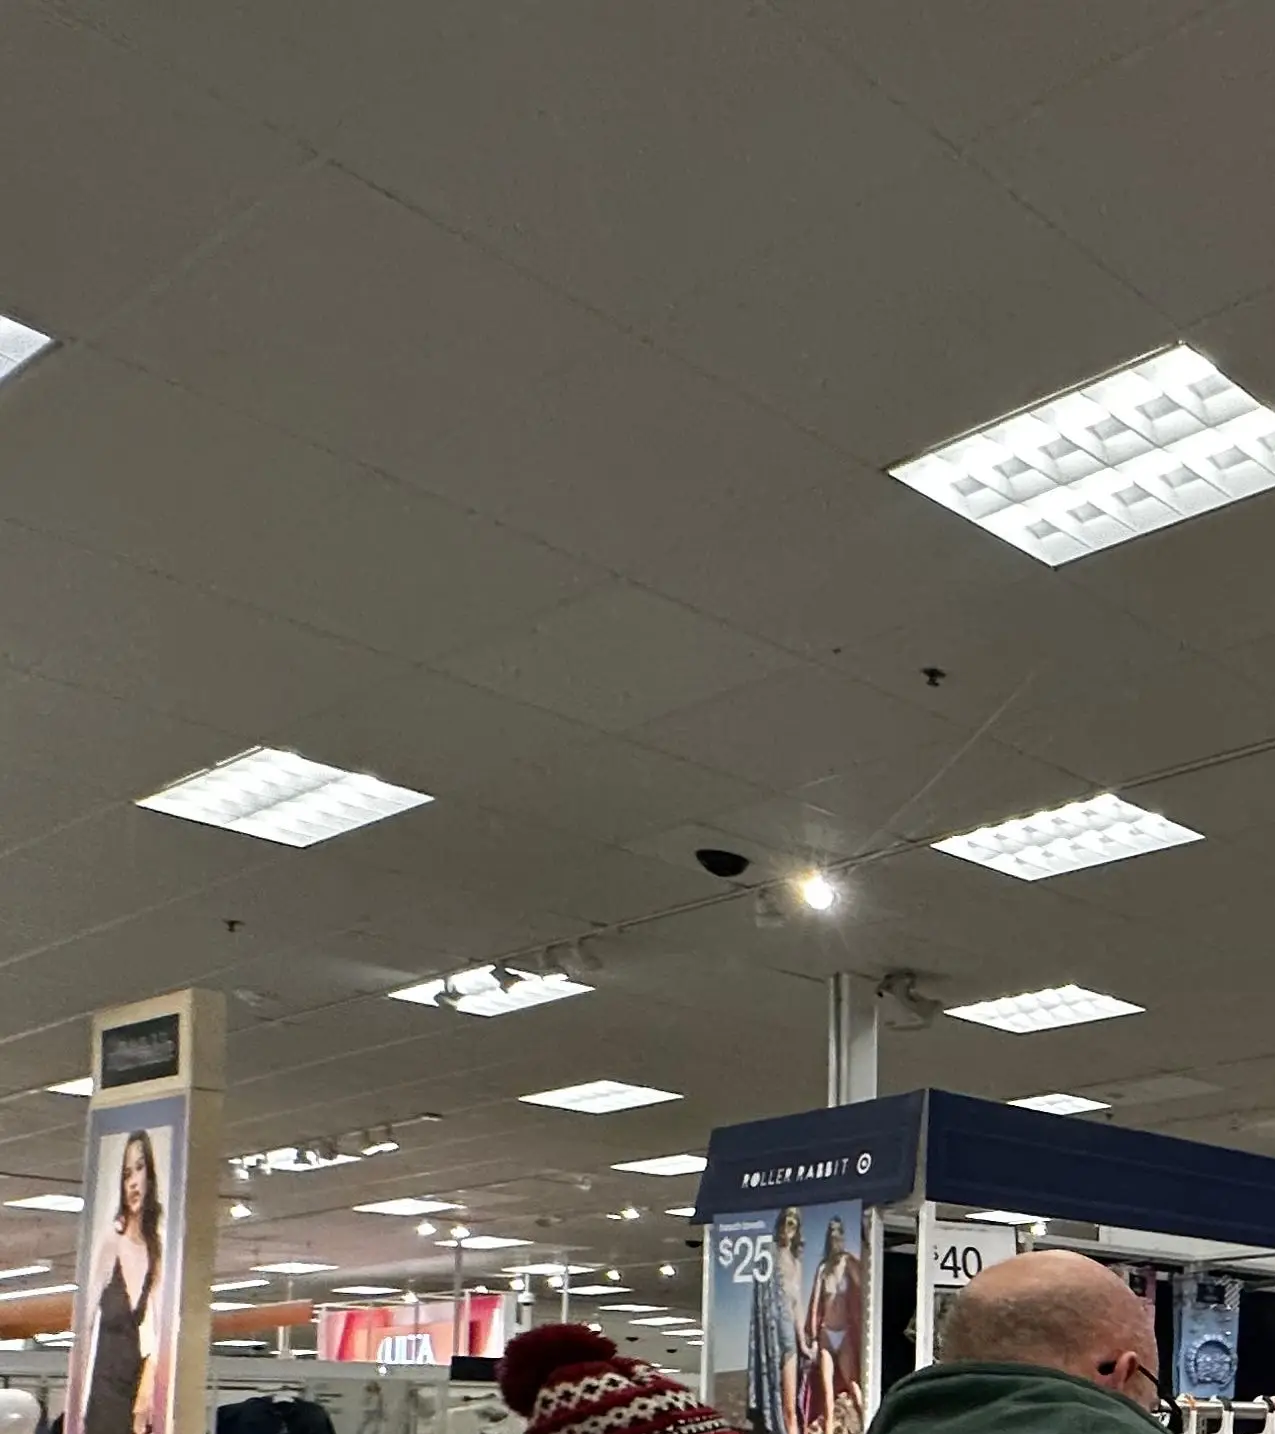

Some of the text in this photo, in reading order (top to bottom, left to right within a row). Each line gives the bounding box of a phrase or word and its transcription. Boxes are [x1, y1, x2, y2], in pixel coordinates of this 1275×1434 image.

[741, 1157, 849, 1189] ROLLER RABBIT
[718, 1235, 773, 1283] $25
